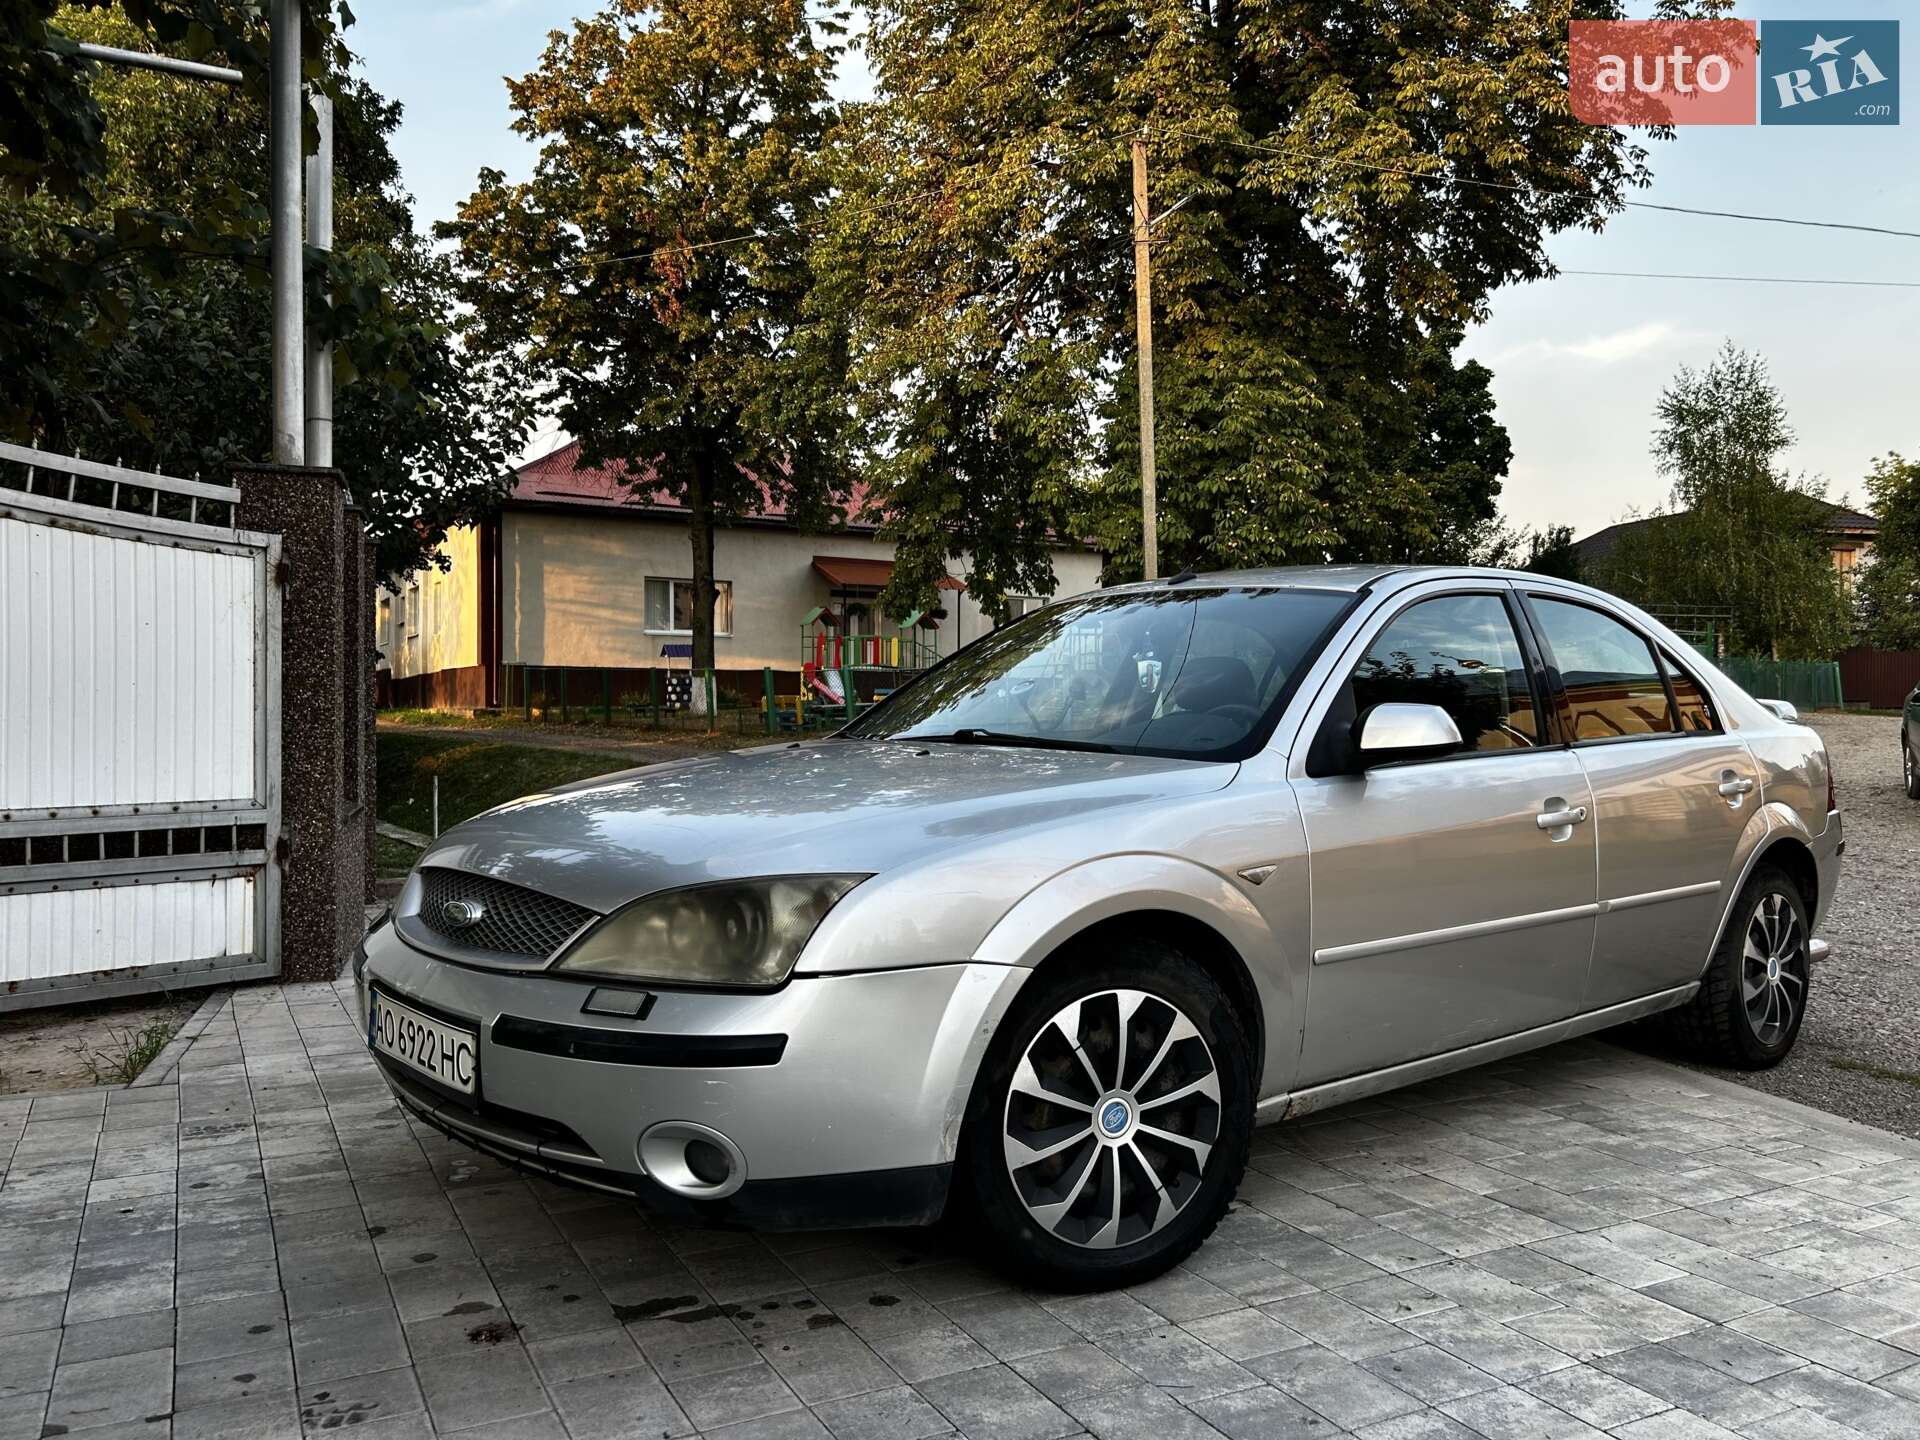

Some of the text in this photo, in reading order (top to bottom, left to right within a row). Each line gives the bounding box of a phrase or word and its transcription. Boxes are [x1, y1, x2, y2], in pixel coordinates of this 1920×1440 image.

[376, 1003, 473, 1085] AO 6922 HC
